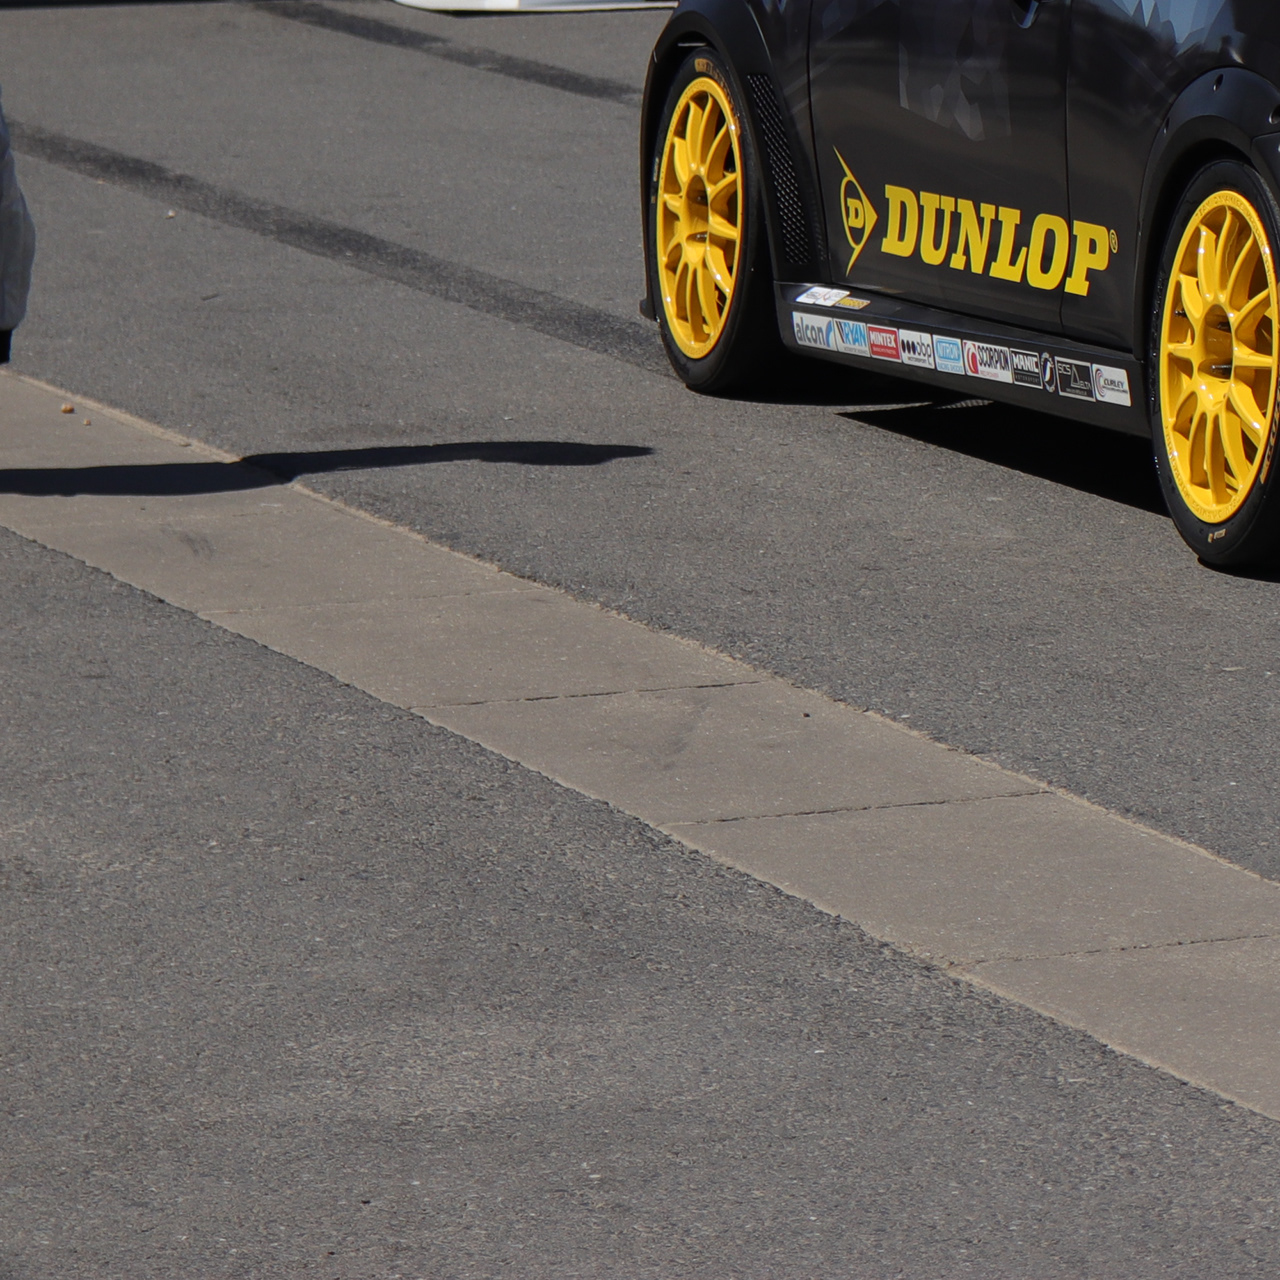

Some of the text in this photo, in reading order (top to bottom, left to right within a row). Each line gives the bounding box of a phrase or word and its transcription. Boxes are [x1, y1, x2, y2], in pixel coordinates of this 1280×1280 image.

[881, 184, 1110, 296] DUNLOP
[795, 317, 825, 346] alcon
[843, 322, 867, 347] RYAN
[870, 331, 896, 348] MINTEX
[978, 345, 1010, 372] SCORPION
[1012, 353, 1039, 373] MANIC
[1058, 363, 1071, 375] SCS
